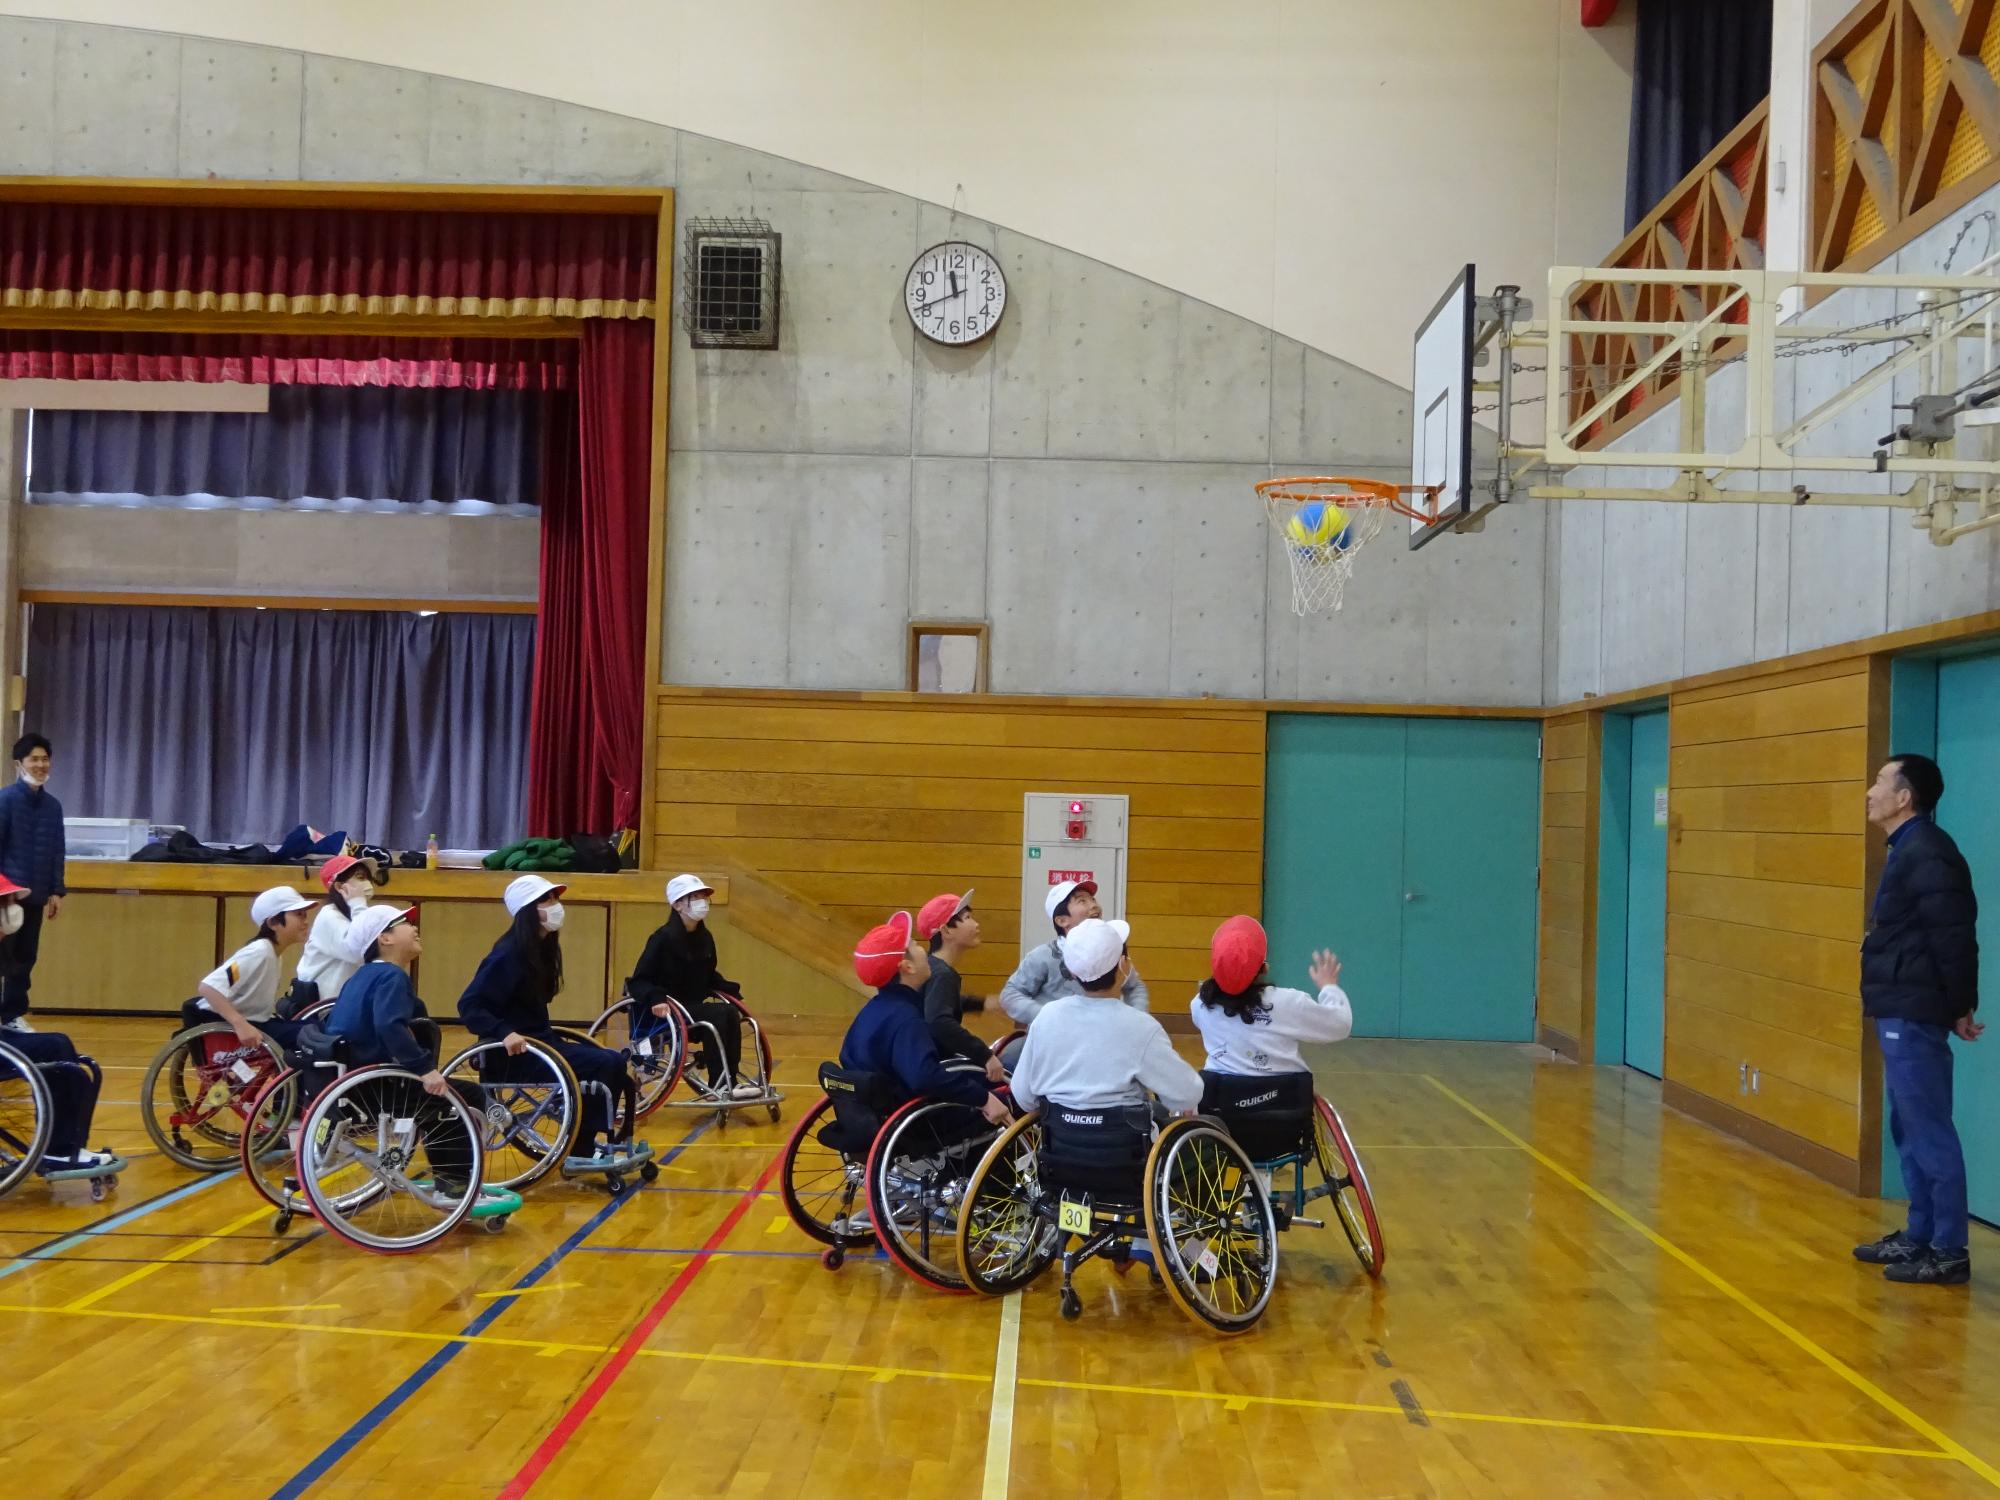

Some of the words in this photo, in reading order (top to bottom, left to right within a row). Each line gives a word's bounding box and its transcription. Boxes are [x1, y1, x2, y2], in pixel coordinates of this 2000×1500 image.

[935, 258, 946, 272] 11
[949, 254, 965, 269] 12
[920, 270, 935, 285] 10
[980, 269, 991, 284] 2
[915, 287, 926, 302] 9
[985, 286, 996, 301] 3
[921, 303, 932, 317] 8
[979, 304, 990, 317] 4
[934, 316, 945, 331] 7
[949, 320, 960, 335] 6
[966, 316, 977, 330] 5
[1239, 1089, 1278, 1108] QUICKIE
[1064, 1113, 1104, 1125] QUICKIE
[1065, 1208, 1083, 1228] 30
